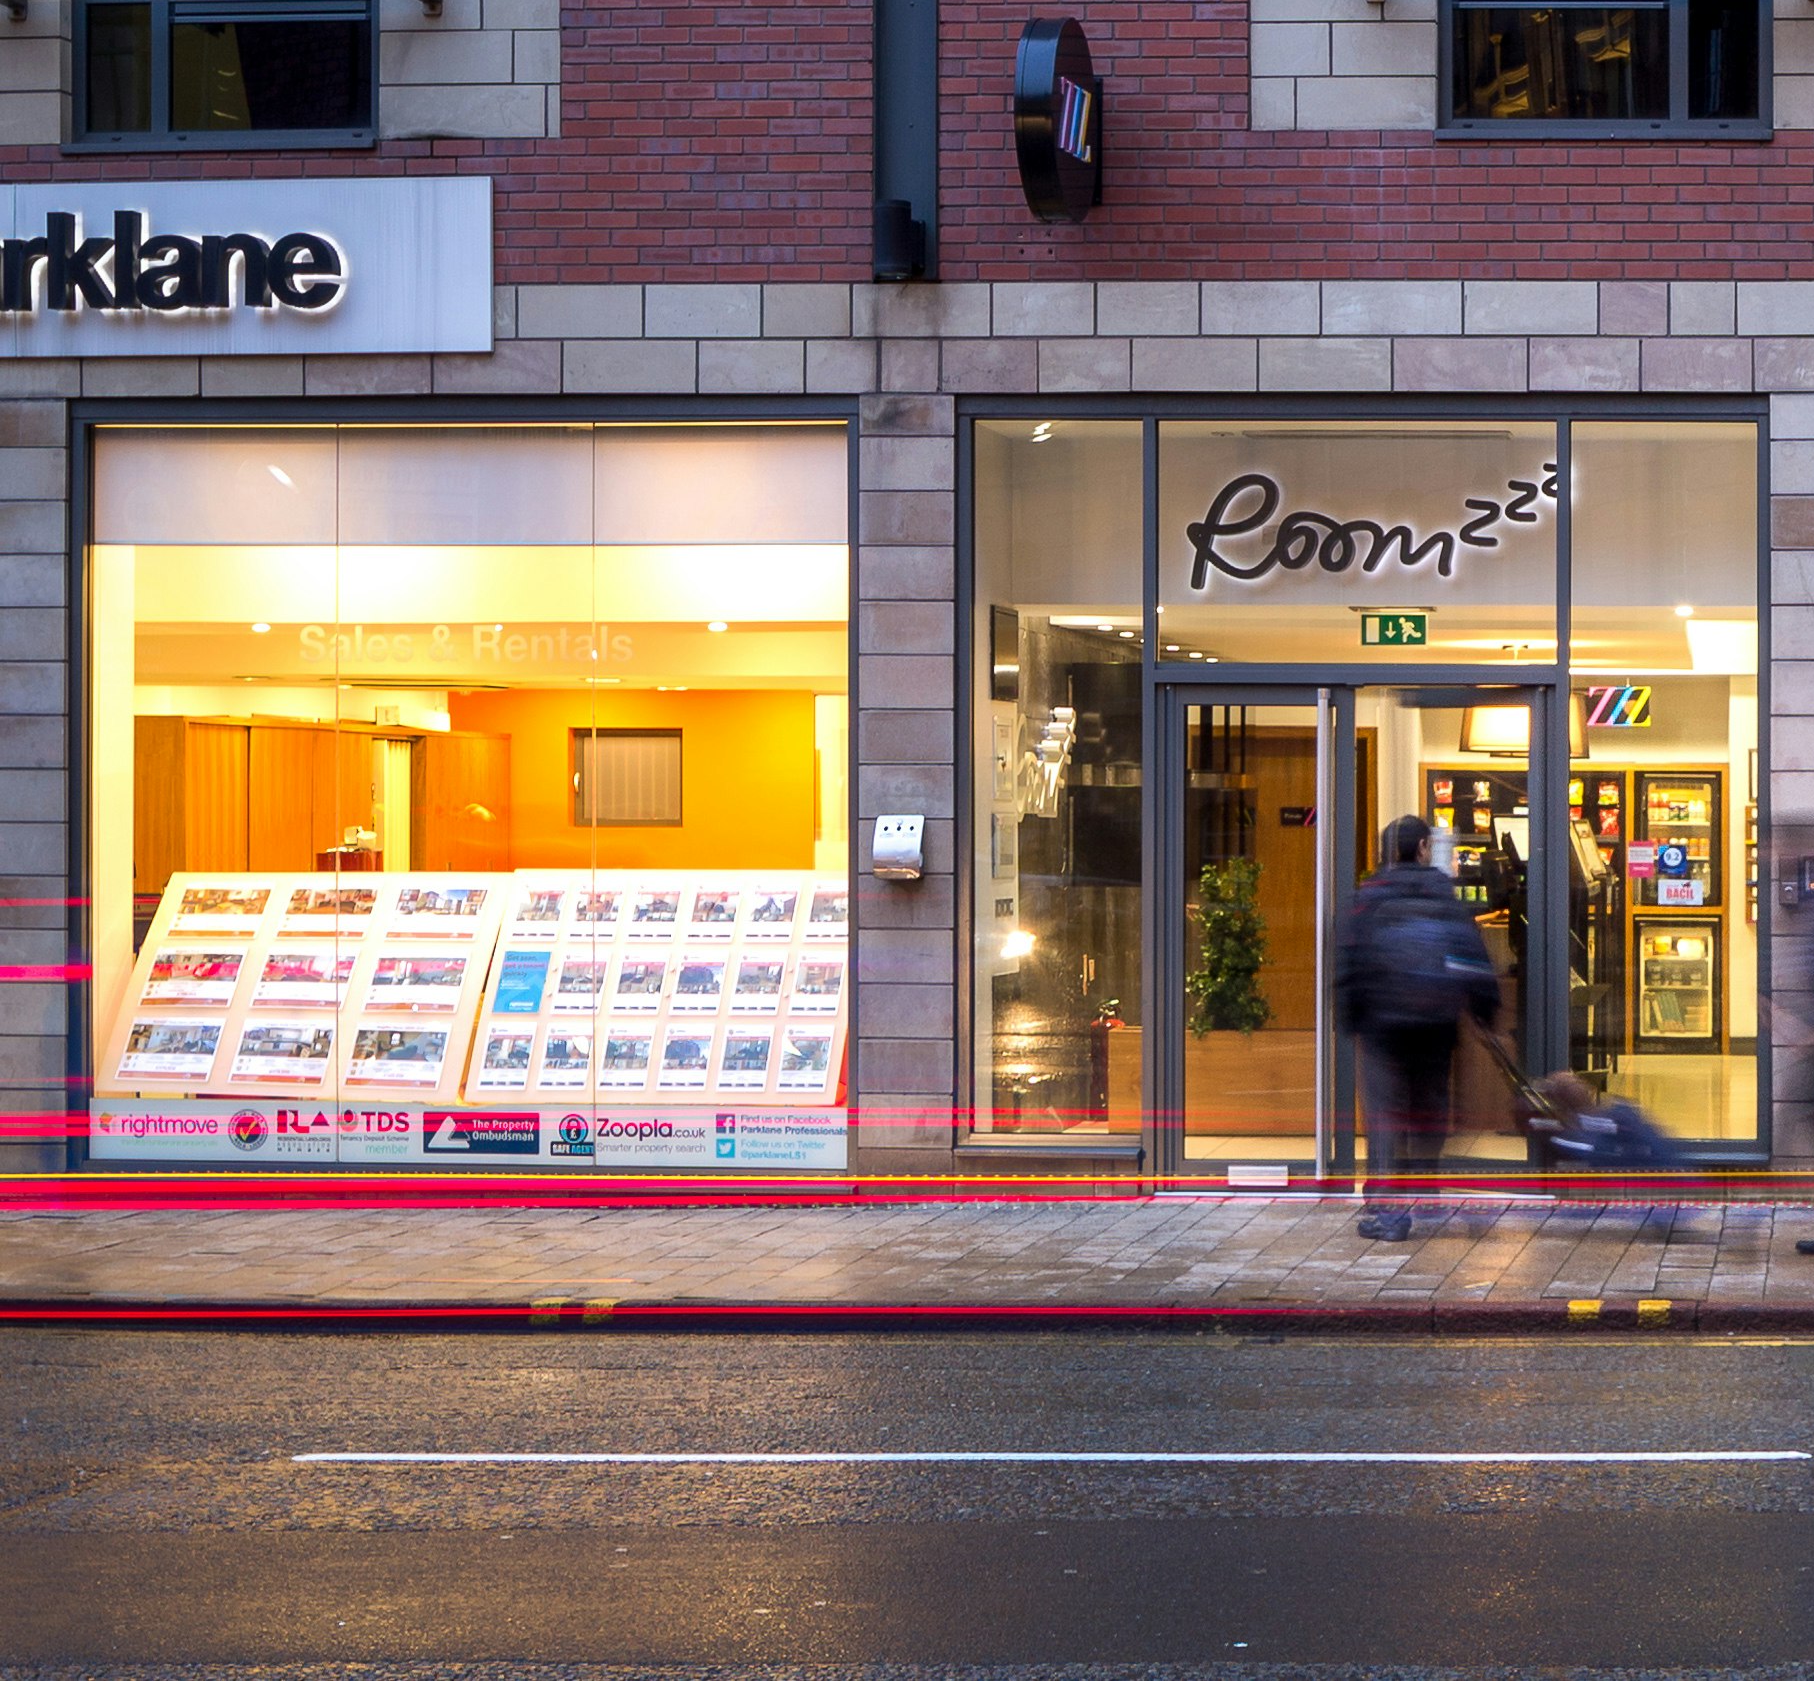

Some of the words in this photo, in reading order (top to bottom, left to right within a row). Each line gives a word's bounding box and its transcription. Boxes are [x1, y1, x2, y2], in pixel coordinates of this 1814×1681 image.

[299, 624, 412, 663] Sales
[428, 624, 459, 663] &
[472, 624, 635, 663] Rentals
[121, 1113, 218, 1138] rightmove
[360, 1111, 410, 1133] TDS
[472, 1119, 490, 1129] The
[492, 1119, 535, 1132] Property
[741, 1114, 758, 1124] Find
[761, 1116, 773, 1124] us
[775, 1116, 786, 1124] on
[788, 1115, 832, 1125] Facebook
[472, 1130, 535, 1142] Ombudsman
[596, 1118, 706, 1141] Zoopla.co.uk
[741, 1126, 782, 1134] Parklane
[785, 1126, 848, 1136] Professionals
[365, 1142, 409, 1155] member
[552, 1143, 571, 1154] SAFE
[596, 1142, 632, 1153] Smarter
[635, 1143, 673, 1155] property
[675, 1143, 706, 1153] search
[741, 1138, 768, 1148] Follow
[771, 1140, 782, 1148] us
[784, 1140, 795, 1149] on
[797, 1140, 826, 1149] Twitter
